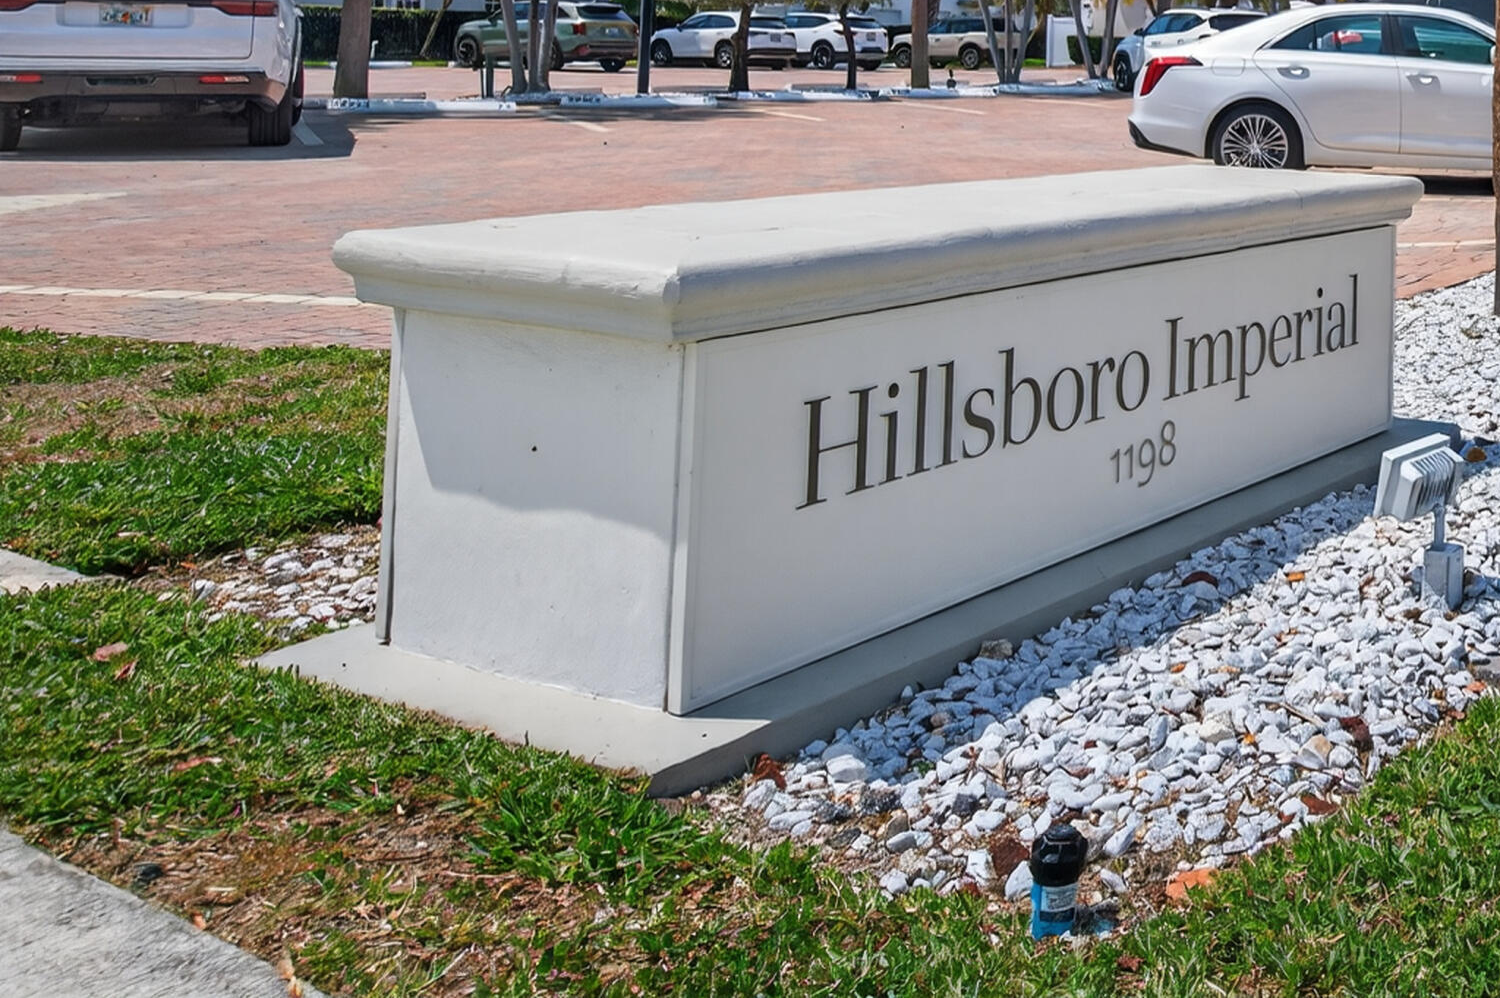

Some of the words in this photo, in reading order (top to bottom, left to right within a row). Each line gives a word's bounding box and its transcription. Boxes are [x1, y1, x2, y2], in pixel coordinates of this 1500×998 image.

[796, 347, 1150, 510] Hillsboro
[1163, 274, 1360, 401] Imperial
[1110, 420, 1177, 488] 1198
